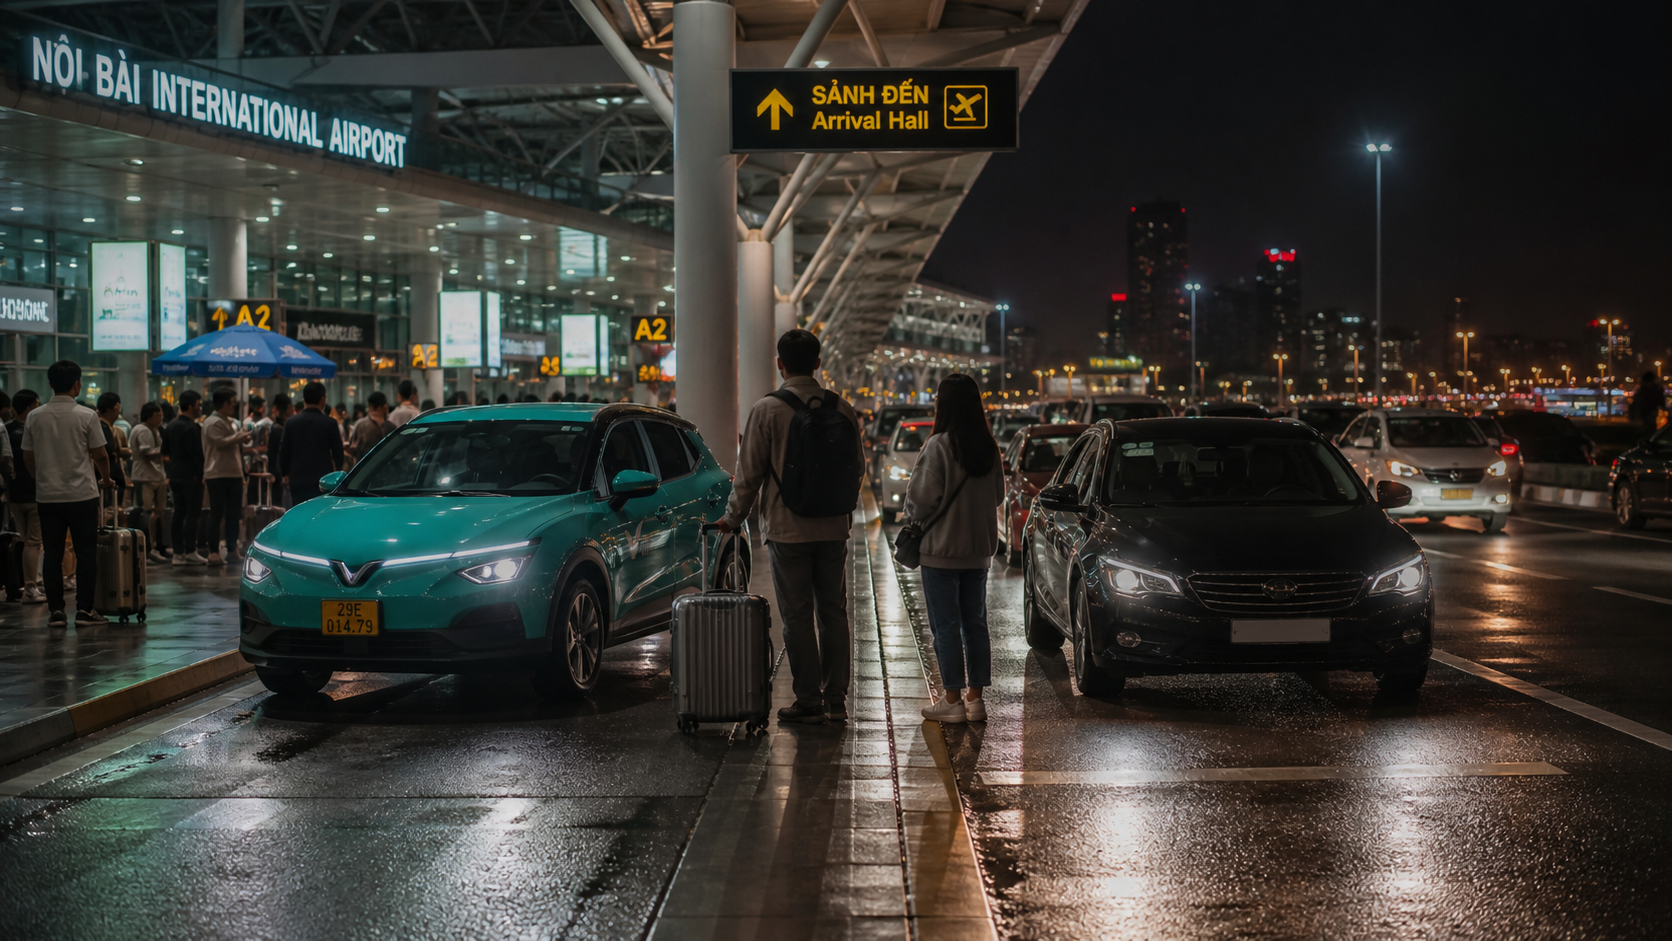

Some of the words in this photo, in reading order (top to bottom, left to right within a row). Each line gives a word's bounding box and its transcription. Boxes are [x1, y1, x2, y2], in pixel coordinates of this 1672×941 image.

[811, 79, 875, 104] SẢNH
[881, 78, 929, 104] ĐẾN
[96, 49, 140, 105] BÀI
[152, 69, 323, 148] INTERNATIONAL
[329, 118, 407, 168] AIRPORT
[811, 110, 881, 130] Arrival
[889, 110, 929, 130] Hall
[235, 304, 271, 331] A2
[634, 317, 667, 341] A2
[337, 602, 362, 617] 29E
[327, 618, 373, 633] 014.79
